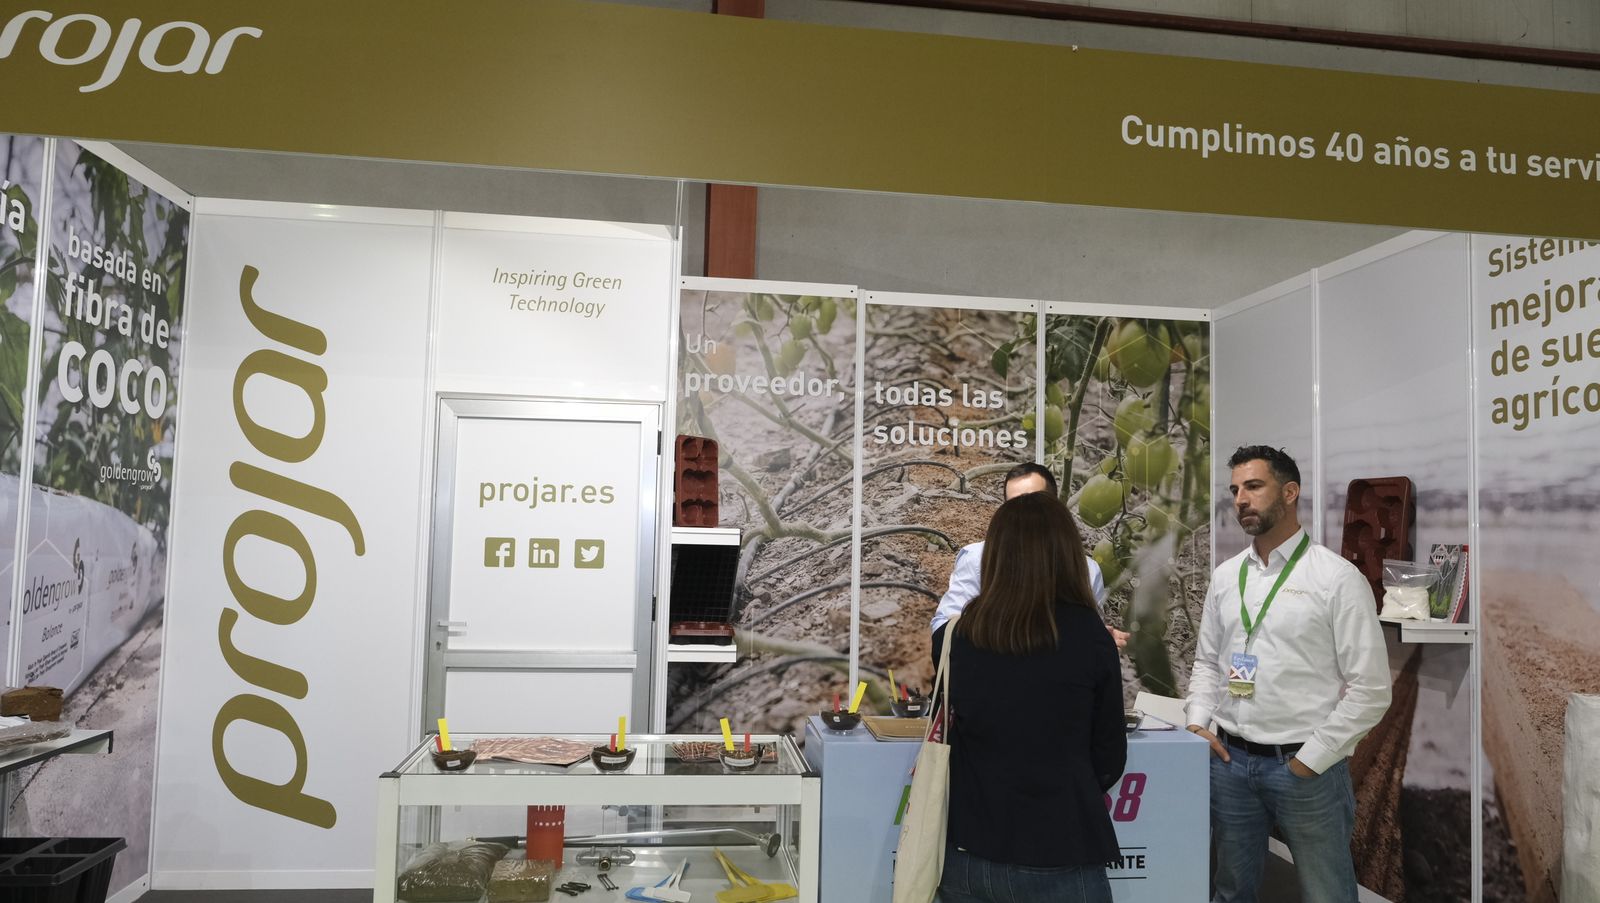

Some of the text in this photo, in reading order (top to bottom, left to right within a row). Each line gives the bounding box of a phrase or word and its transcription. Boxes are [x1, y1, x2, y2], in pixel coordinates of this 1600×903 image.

[1121, 115, 1316, 159] Cumplimos
[1325, 131, 1364, 163] 40
[1374, 136, 1450, 170] años
[1460, 148, 1477, 172] a
[1486, 146, 1517, 175] tu
[68, 225, 162, 295] basada en
[1488, 238, 1600, 278] Sistem
[492, 267, 623, 291] Inspiring Green
[65, 271, 170, 349] fibra de
[509, 294, 606, 319] Technology
[1491, 276, 1600, 330] mejor
[685, 333, 718, 355] Un
[1491, 339, 1530, 377] de
[684, 371, 1005, 410] proveedor, todas las
[873, 417, 1029, 449] soluciones
[100, 462, 154, 486] goldengrow
[479, 476, 615, 509] projar.es
[212, 264, 366, 830] projar
